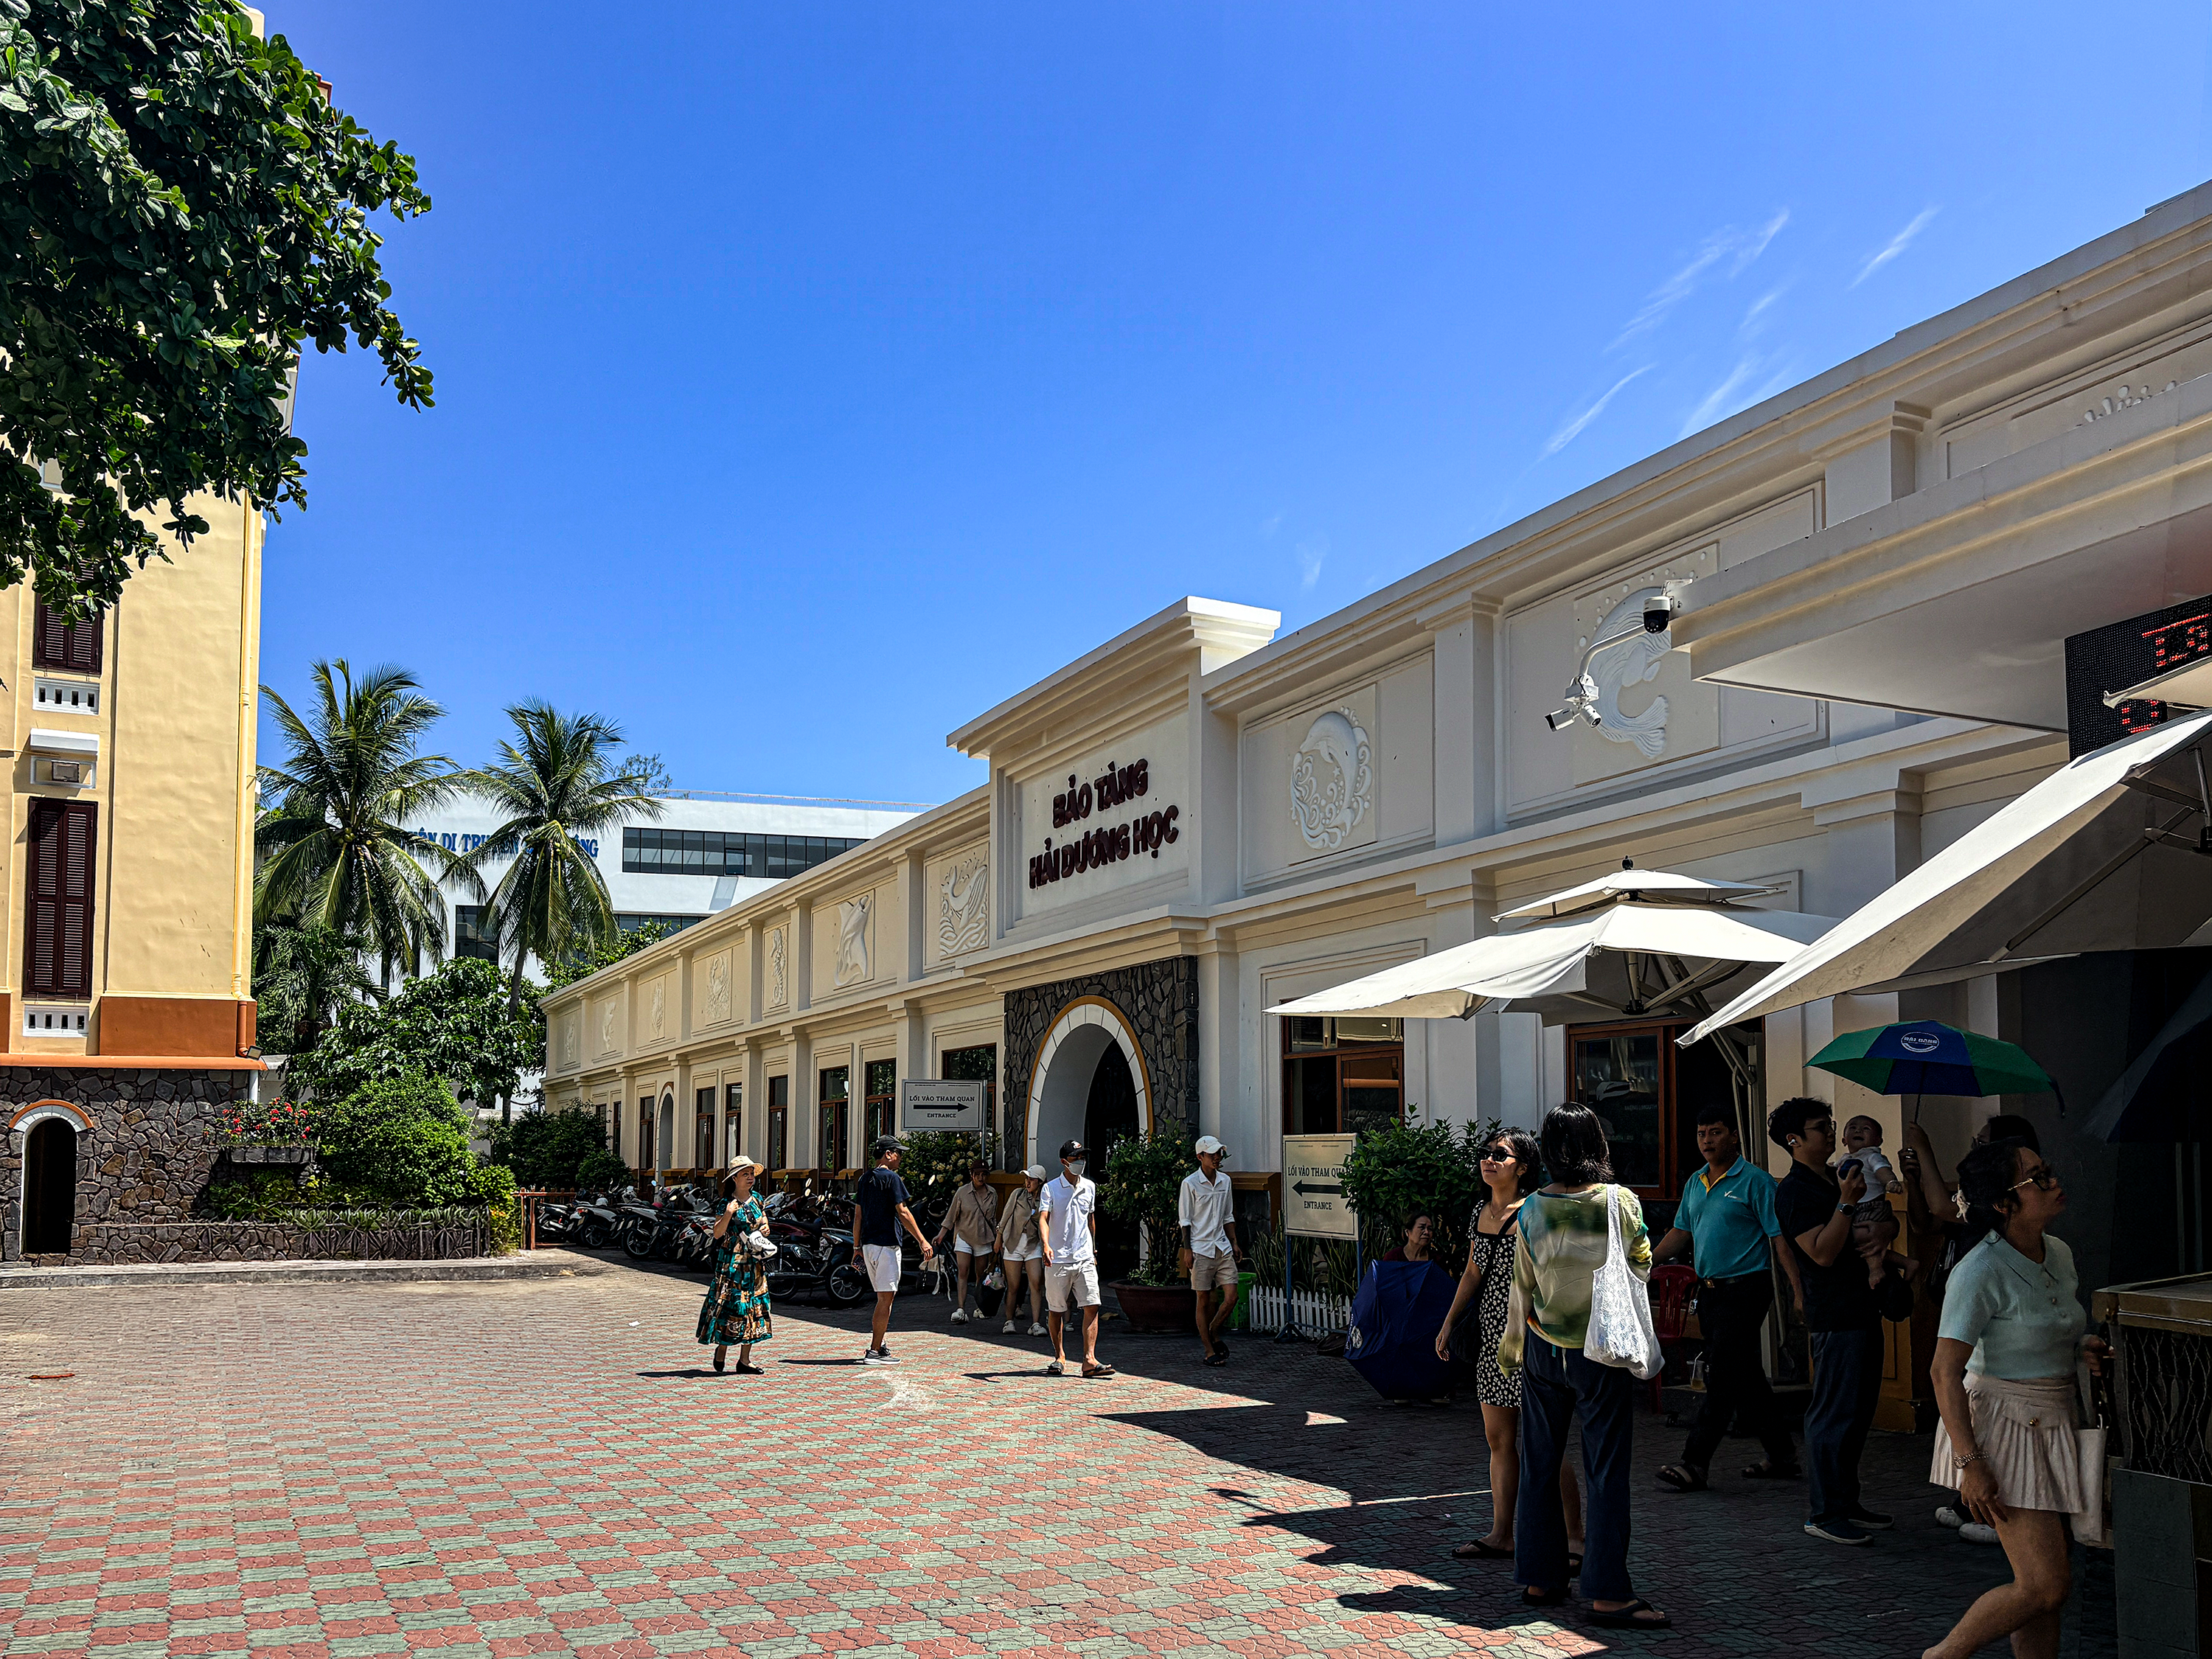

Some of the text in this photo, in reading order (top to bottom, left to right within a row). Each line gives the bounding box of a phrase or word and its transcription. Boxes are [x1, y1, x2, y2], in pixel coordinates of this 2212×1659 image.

[1052, 758, 1149, 829] BẢO TÀNG
[442, 833, 457, 852] DI
[1029, 804, 1179, 889] HẢI DƯƠNG HỌC
[1288, 1164, 1297, 1176] LỐI
[1298, 1165, 1310, 1176] VÀO
[1311, 1167, 1329, 1177] THAM
[1304, 1200, 1332, 1210] ENTRANCE
